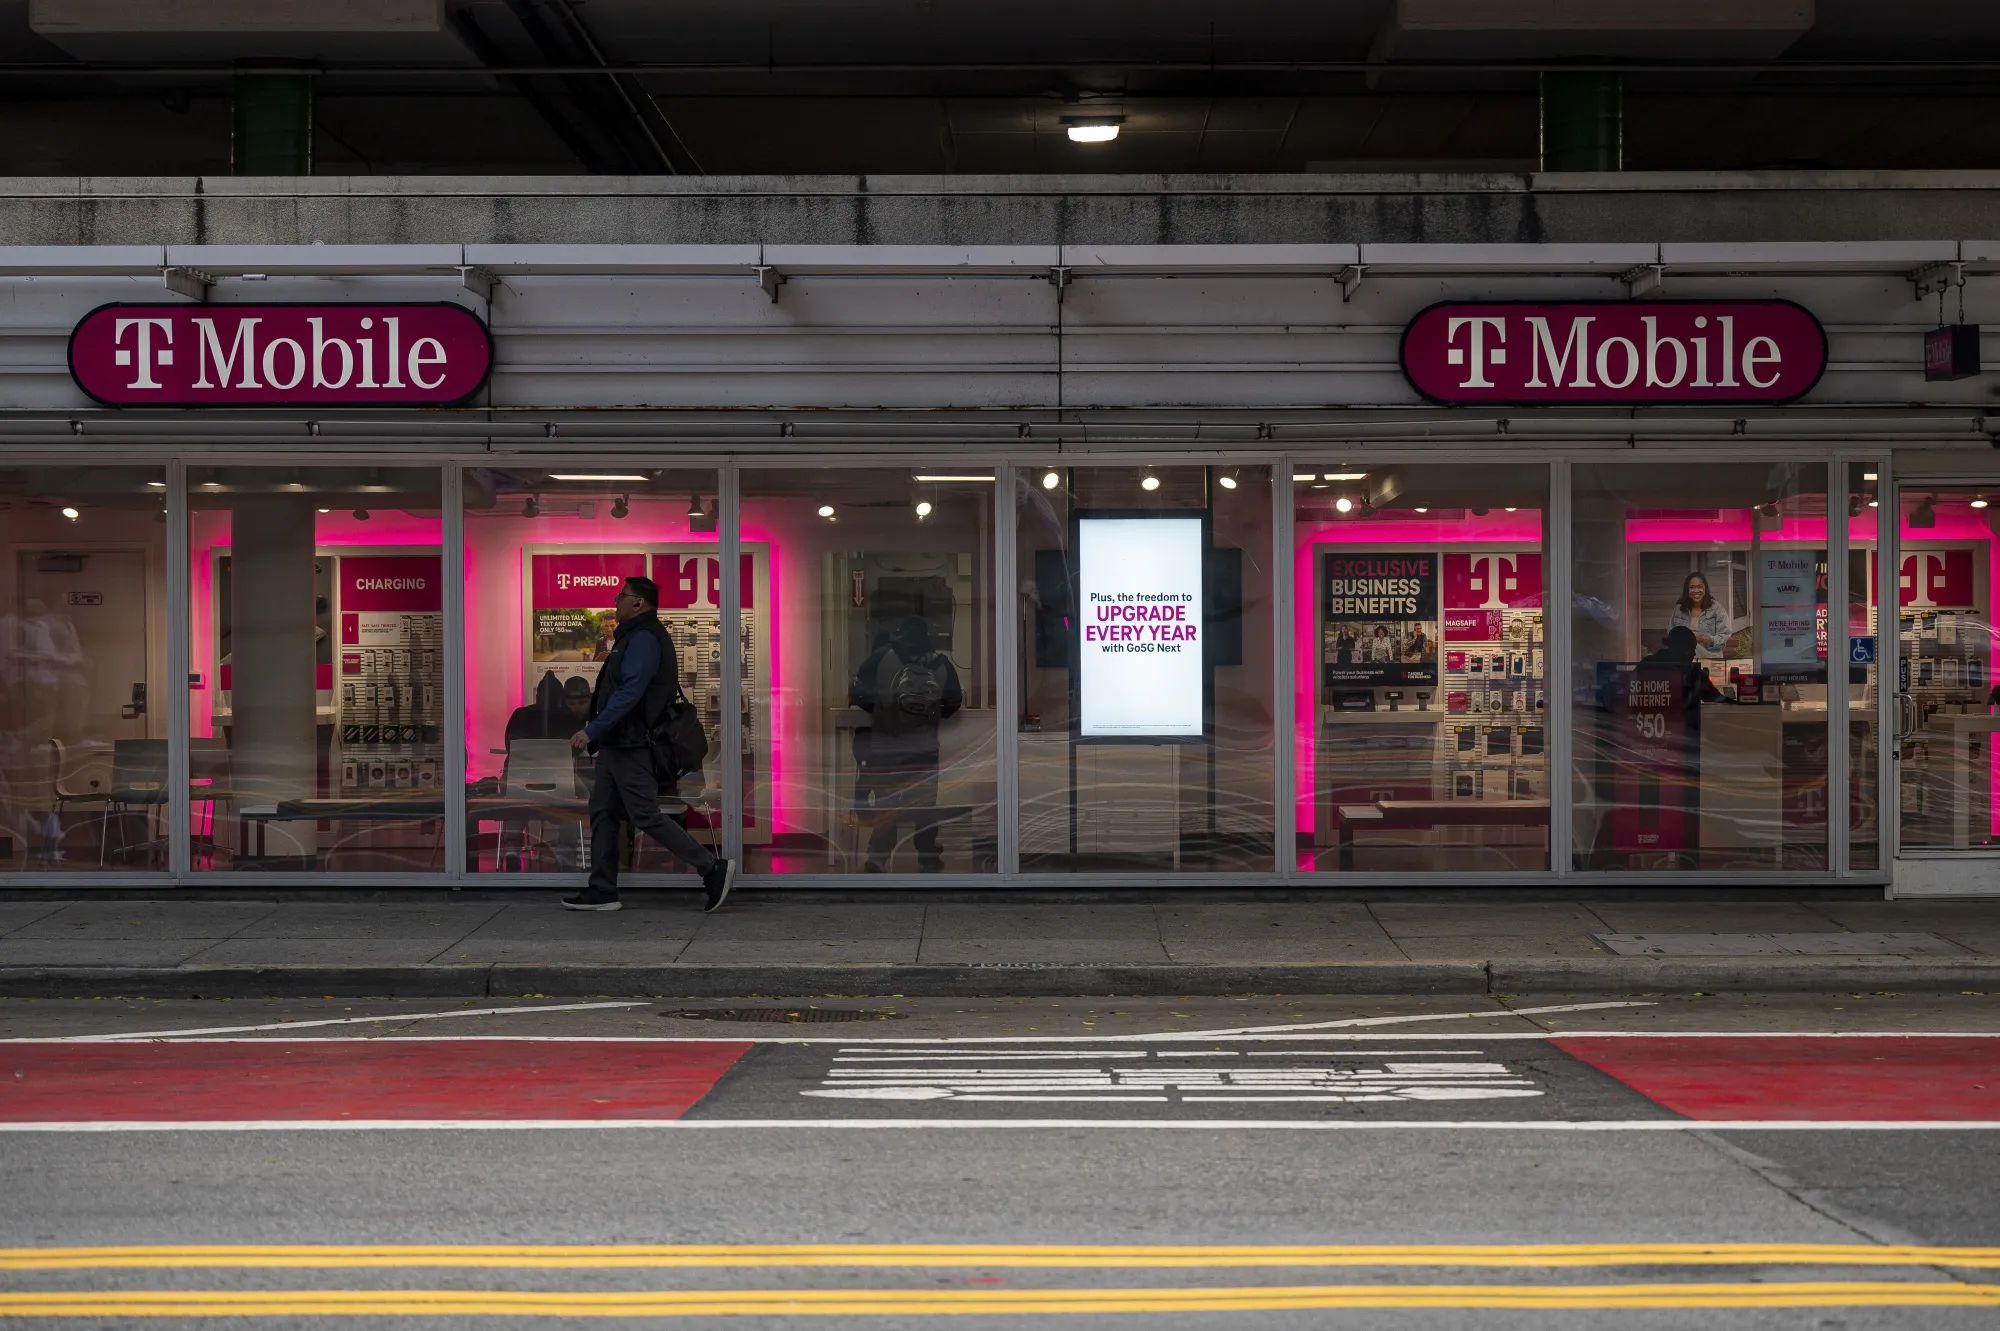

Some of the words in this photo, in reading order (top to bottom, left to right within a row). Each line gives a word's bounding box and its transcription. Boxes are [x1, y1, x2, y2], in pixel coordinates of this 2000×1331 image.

[115, 318, 174, 389] T
[192, 316, 447, 390] Mobile
[1448, 317, 1506, 388] T
[1524, 316, 1782, 389] Mobile
[1332, 560, 1429, 577] EXCLUSIVE
[1778, 560, 1808, 570] Mobile
[356, 578, 426, 590] CHARGING
[557, 573, 570, 589] T
[573, 576, 620, 587] PREPAID
[1332, 579, 1421, 595] BUSINESS
[1470, 553, 1517, 609] T
[1777, 585, 1800, 593] GIANTS
[1090, 592, 1115, 603] Plus,
[1117, 592, 1134, 602] the
[1136, 592, 1179, 602] freedom
[1181, 593, 1193, 602] to
[1332, 597, 1417, 614] BENEFITS
[1097, 605, 1186, 622] UPGRADE
[1445, 619, 1477, 627] MAGSAFE
[1086, 625, 1145, 641] EVERY
[1148, 625, 1197, 641] YEAR
[1102, 643, 1124, 653] with
[1126, 643, 1155, 653] Go5G
[1157, 643, 1181, 653] Next
[1629, 680, 1642, 693] 5G
[1643, 680, 1670, 693] HOME
[1628, 694, 1672, 707] INTERNET
